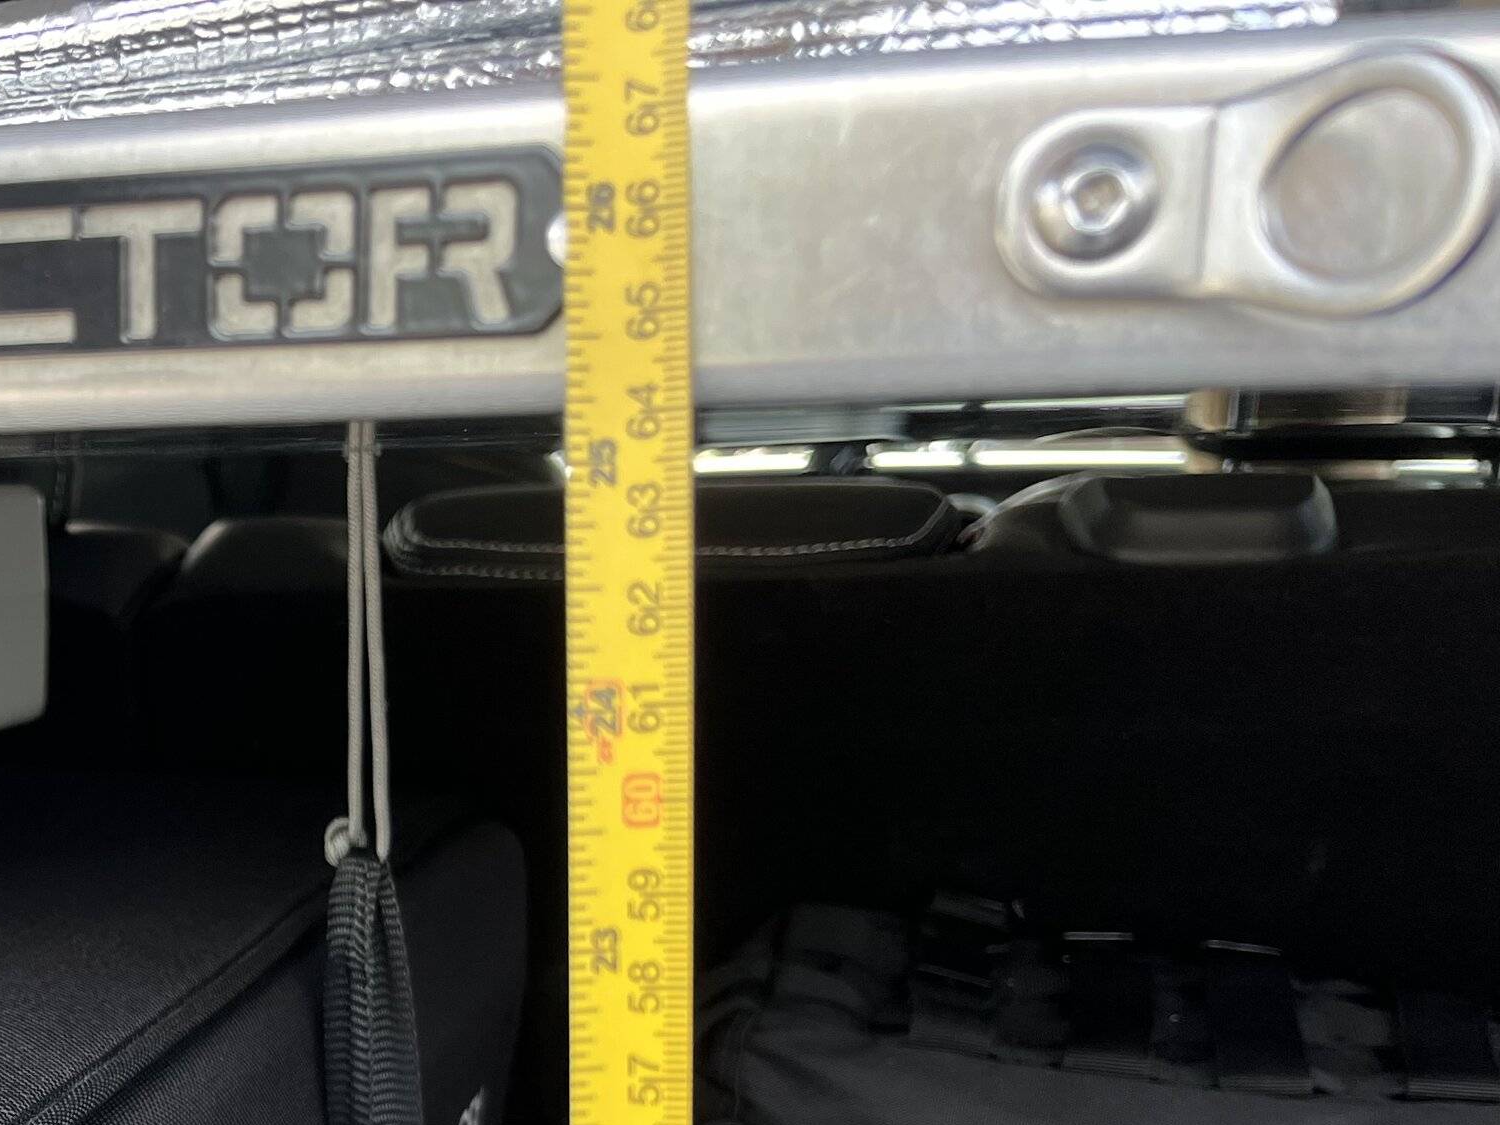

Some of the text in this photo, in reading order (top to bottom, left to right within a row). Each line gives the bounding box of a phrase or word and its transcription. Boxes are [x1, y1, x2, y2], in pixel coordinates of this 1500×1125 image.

[624, 0, 660, 32] 6
[625, 79, 659, 136] 67
[625, 180, 660, 238] 66
[625, 281, 659, 340] 65
[626, 383, 660, 440] 64
[626, 481, 660, 539] 63
[627, 581, 661, 637] 62
[627, 683, 660, 734] 61
[627, 868, 660, 922] 59
[590, 926, 620, 975] 23
[627, 960, 660, 1014] 58
[627, 1055, 660, 1106] 57
